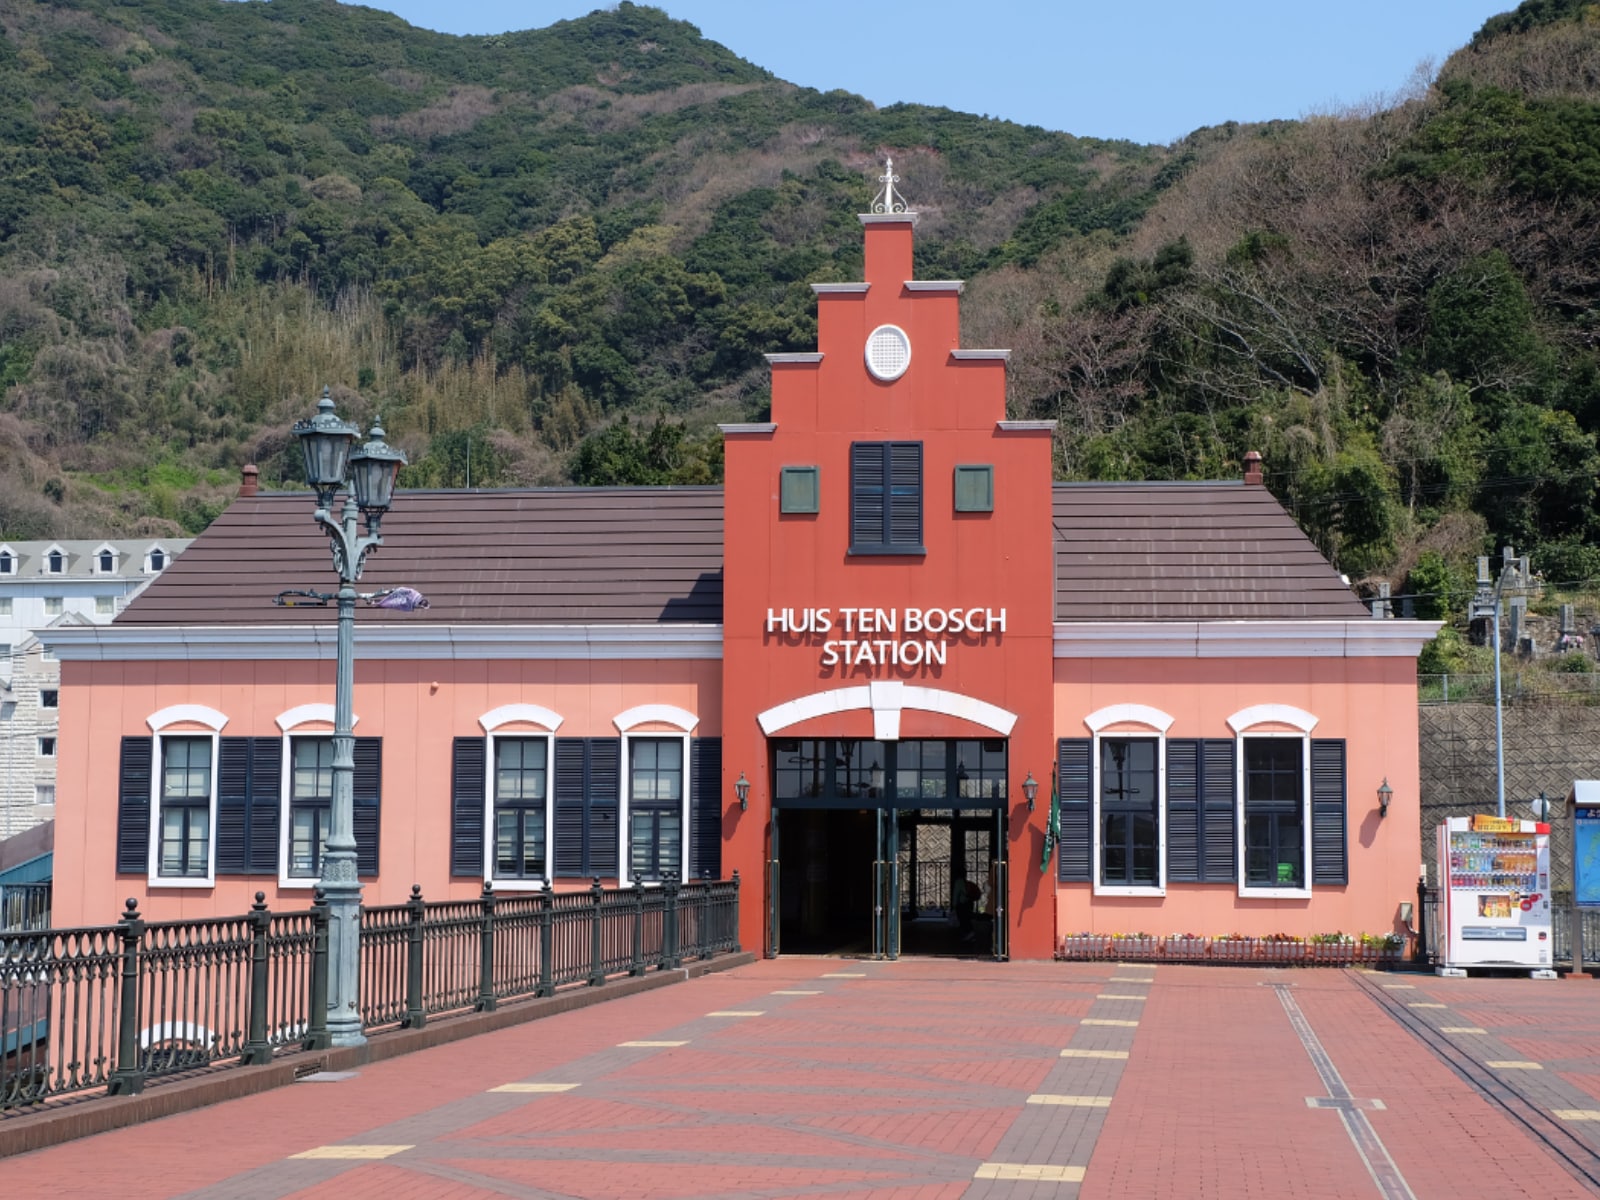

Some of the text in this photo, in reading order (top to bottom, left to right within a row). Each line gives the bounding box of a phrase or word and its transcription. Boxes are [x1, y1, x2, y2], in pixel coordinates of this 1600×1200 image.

[767, 608, 1007, 632] HUIS TEN BOSCH
[822, 640, 947, 665] STATION
